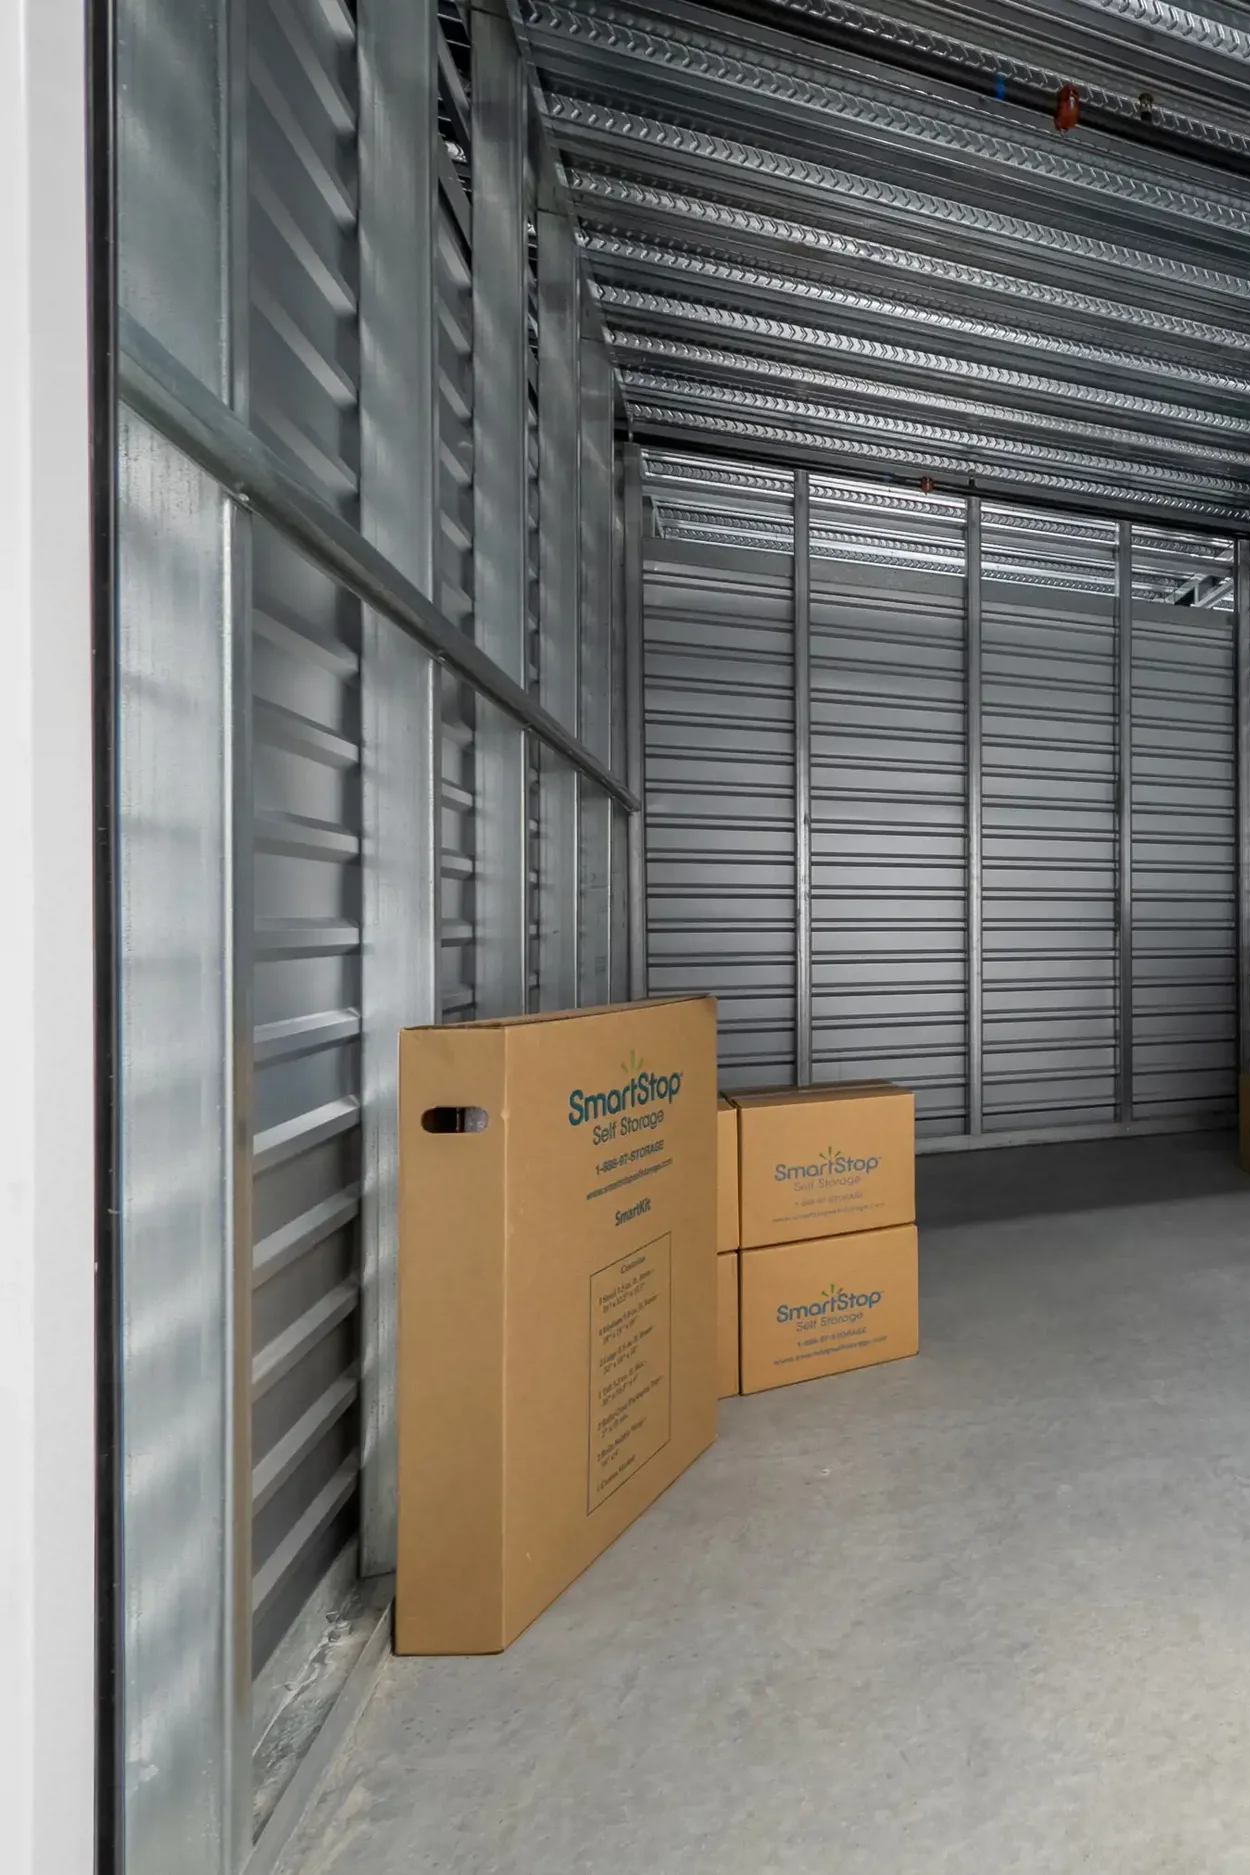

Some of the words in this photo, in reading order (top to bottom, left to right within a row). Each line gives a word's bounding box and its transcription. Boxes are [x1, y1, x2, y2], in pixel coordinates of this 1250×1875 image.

[568, 1071, 681, 1126] SmartStop
[592, 1120, 617, 1146] Self
[620, 1109, 664, 1136] Storage
[774, 1156, 880, 1182] SmartStop
[793, 1180, 815, 1192] Self
[817, 1175, 862, 1189] Storage
[614, 1197, 651, 1227] SmartKit
[776, 1290, 882, 1324] SmartStop
[796, 1319, 818, 1332] Self
[820, 1312, 864, 1327] Storage
